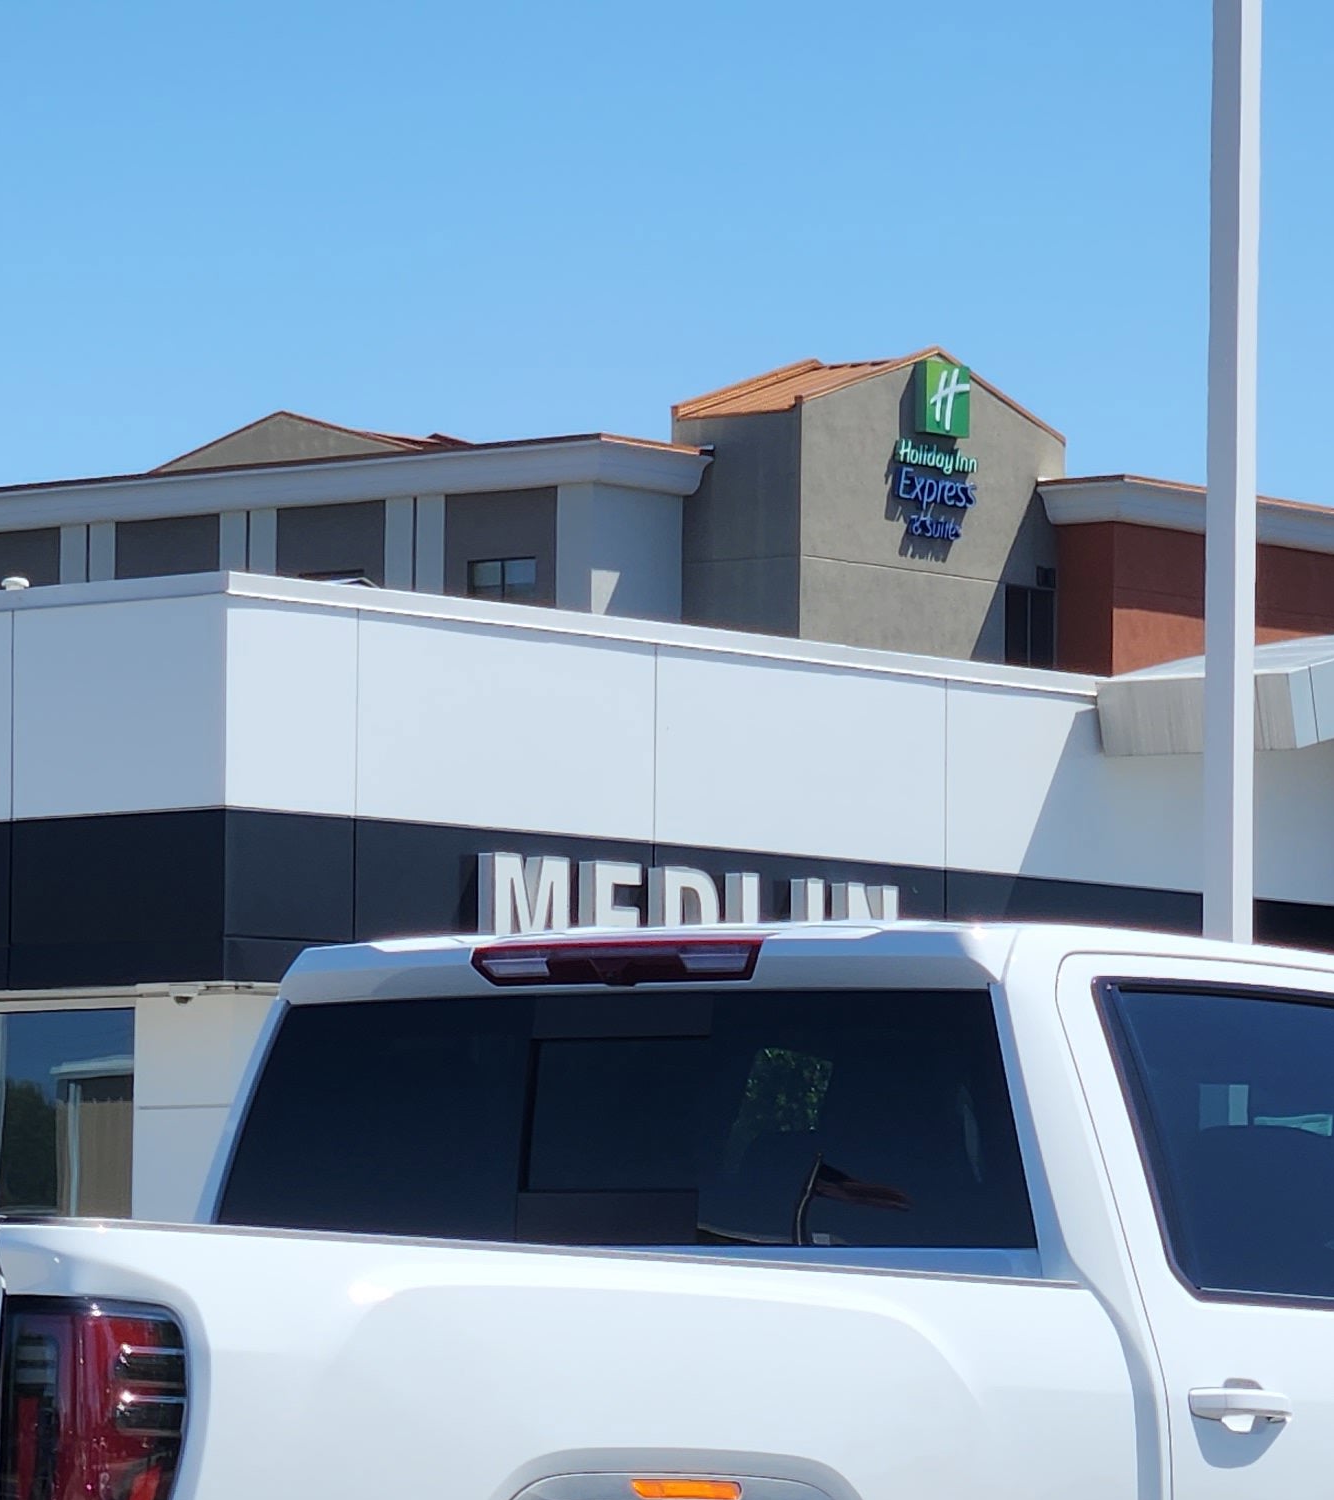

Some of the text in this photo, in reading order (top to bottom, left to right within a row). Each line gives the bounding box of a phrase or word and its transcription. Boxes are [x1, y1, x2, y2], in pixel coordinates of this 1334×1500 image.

[899, 438, 978, 475] Holiday Inn
[899, 467, 977, 510] Express
